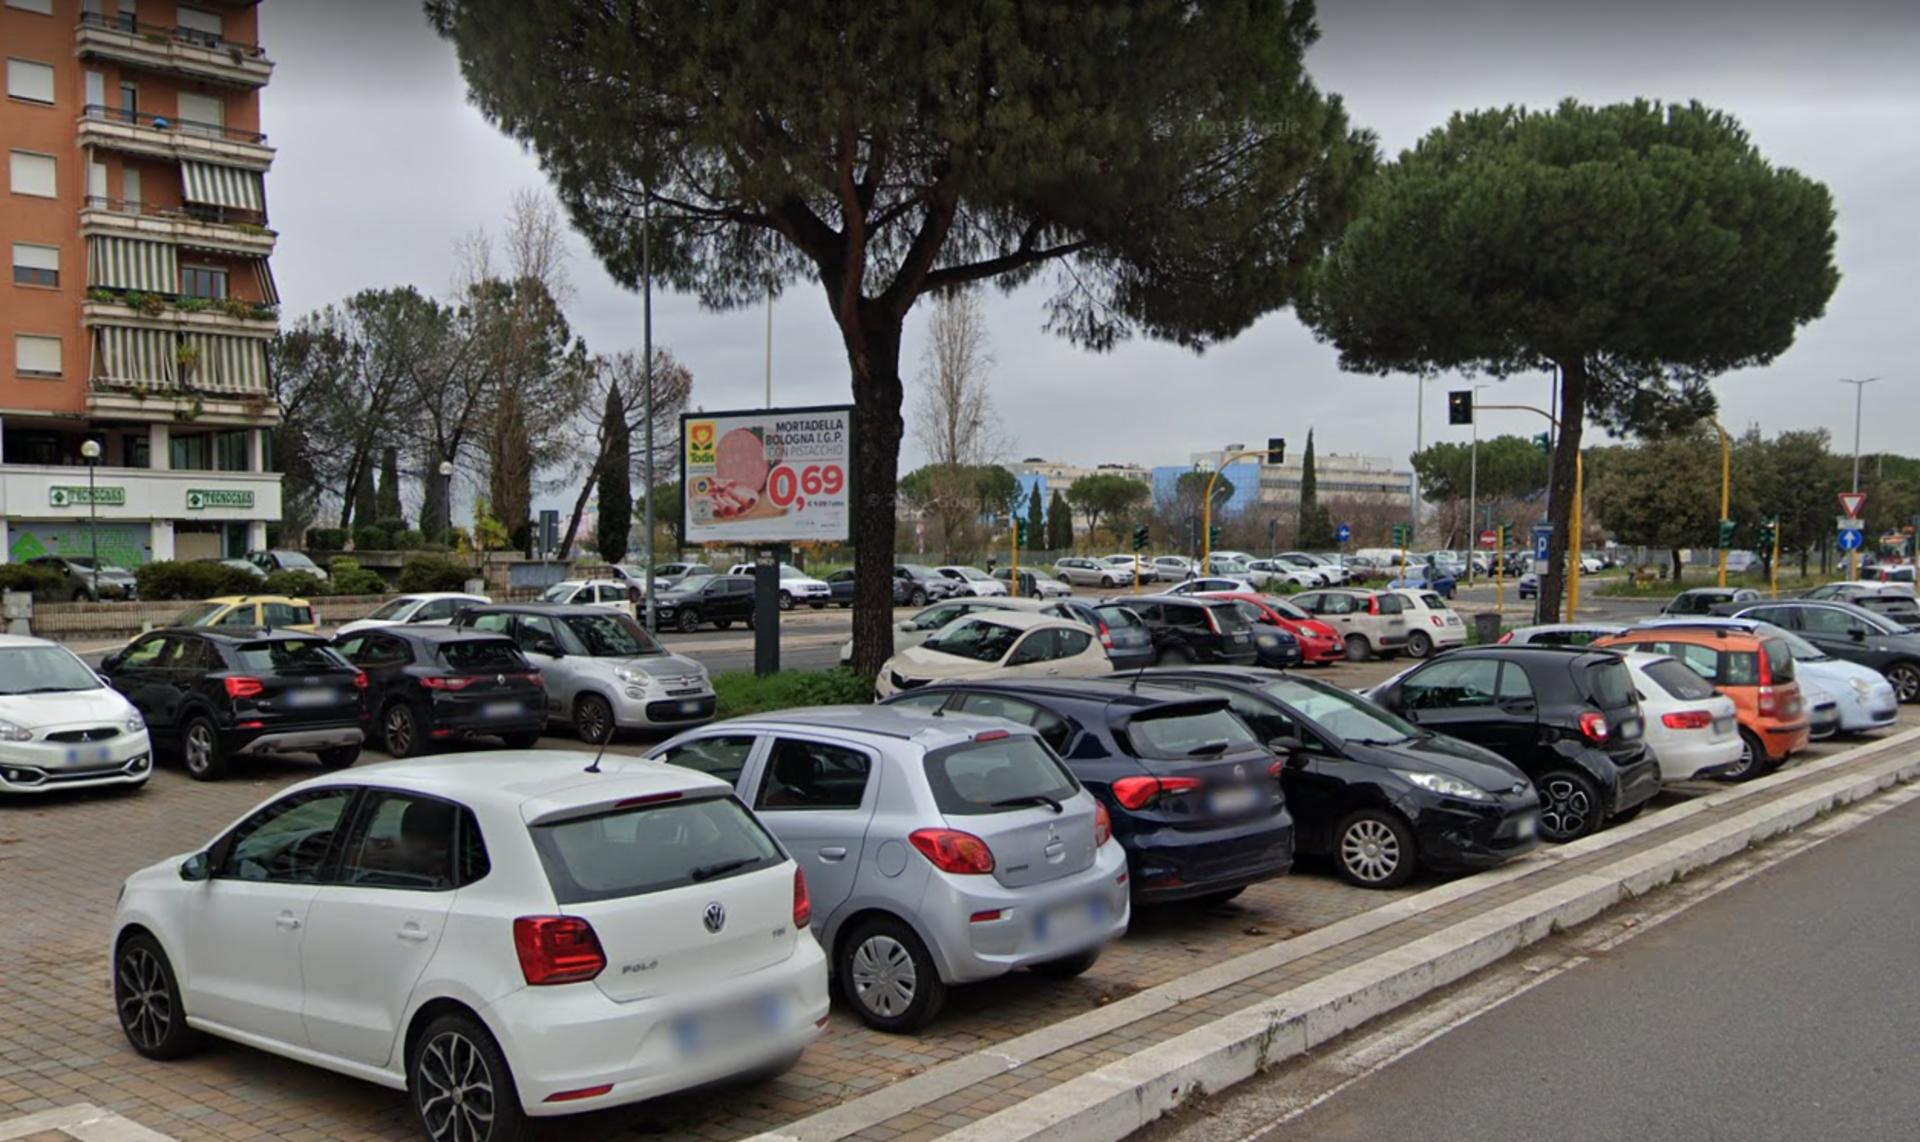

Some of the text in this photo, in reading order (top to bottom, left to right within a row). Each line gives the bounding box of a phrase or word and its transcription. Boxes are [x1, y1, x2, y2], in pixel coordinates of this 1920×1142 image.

[776, 419, 843, 432] MORTADELLA
[766, 431, 843, 446] BOLOGNA I.G.P.
[768, 444, 843, 458] CON PISTACCHIO
[769, 465, 844, 511] 0,69
[1538, 537, 1547, 557] P
[622, 961, 658, 974] POLO
